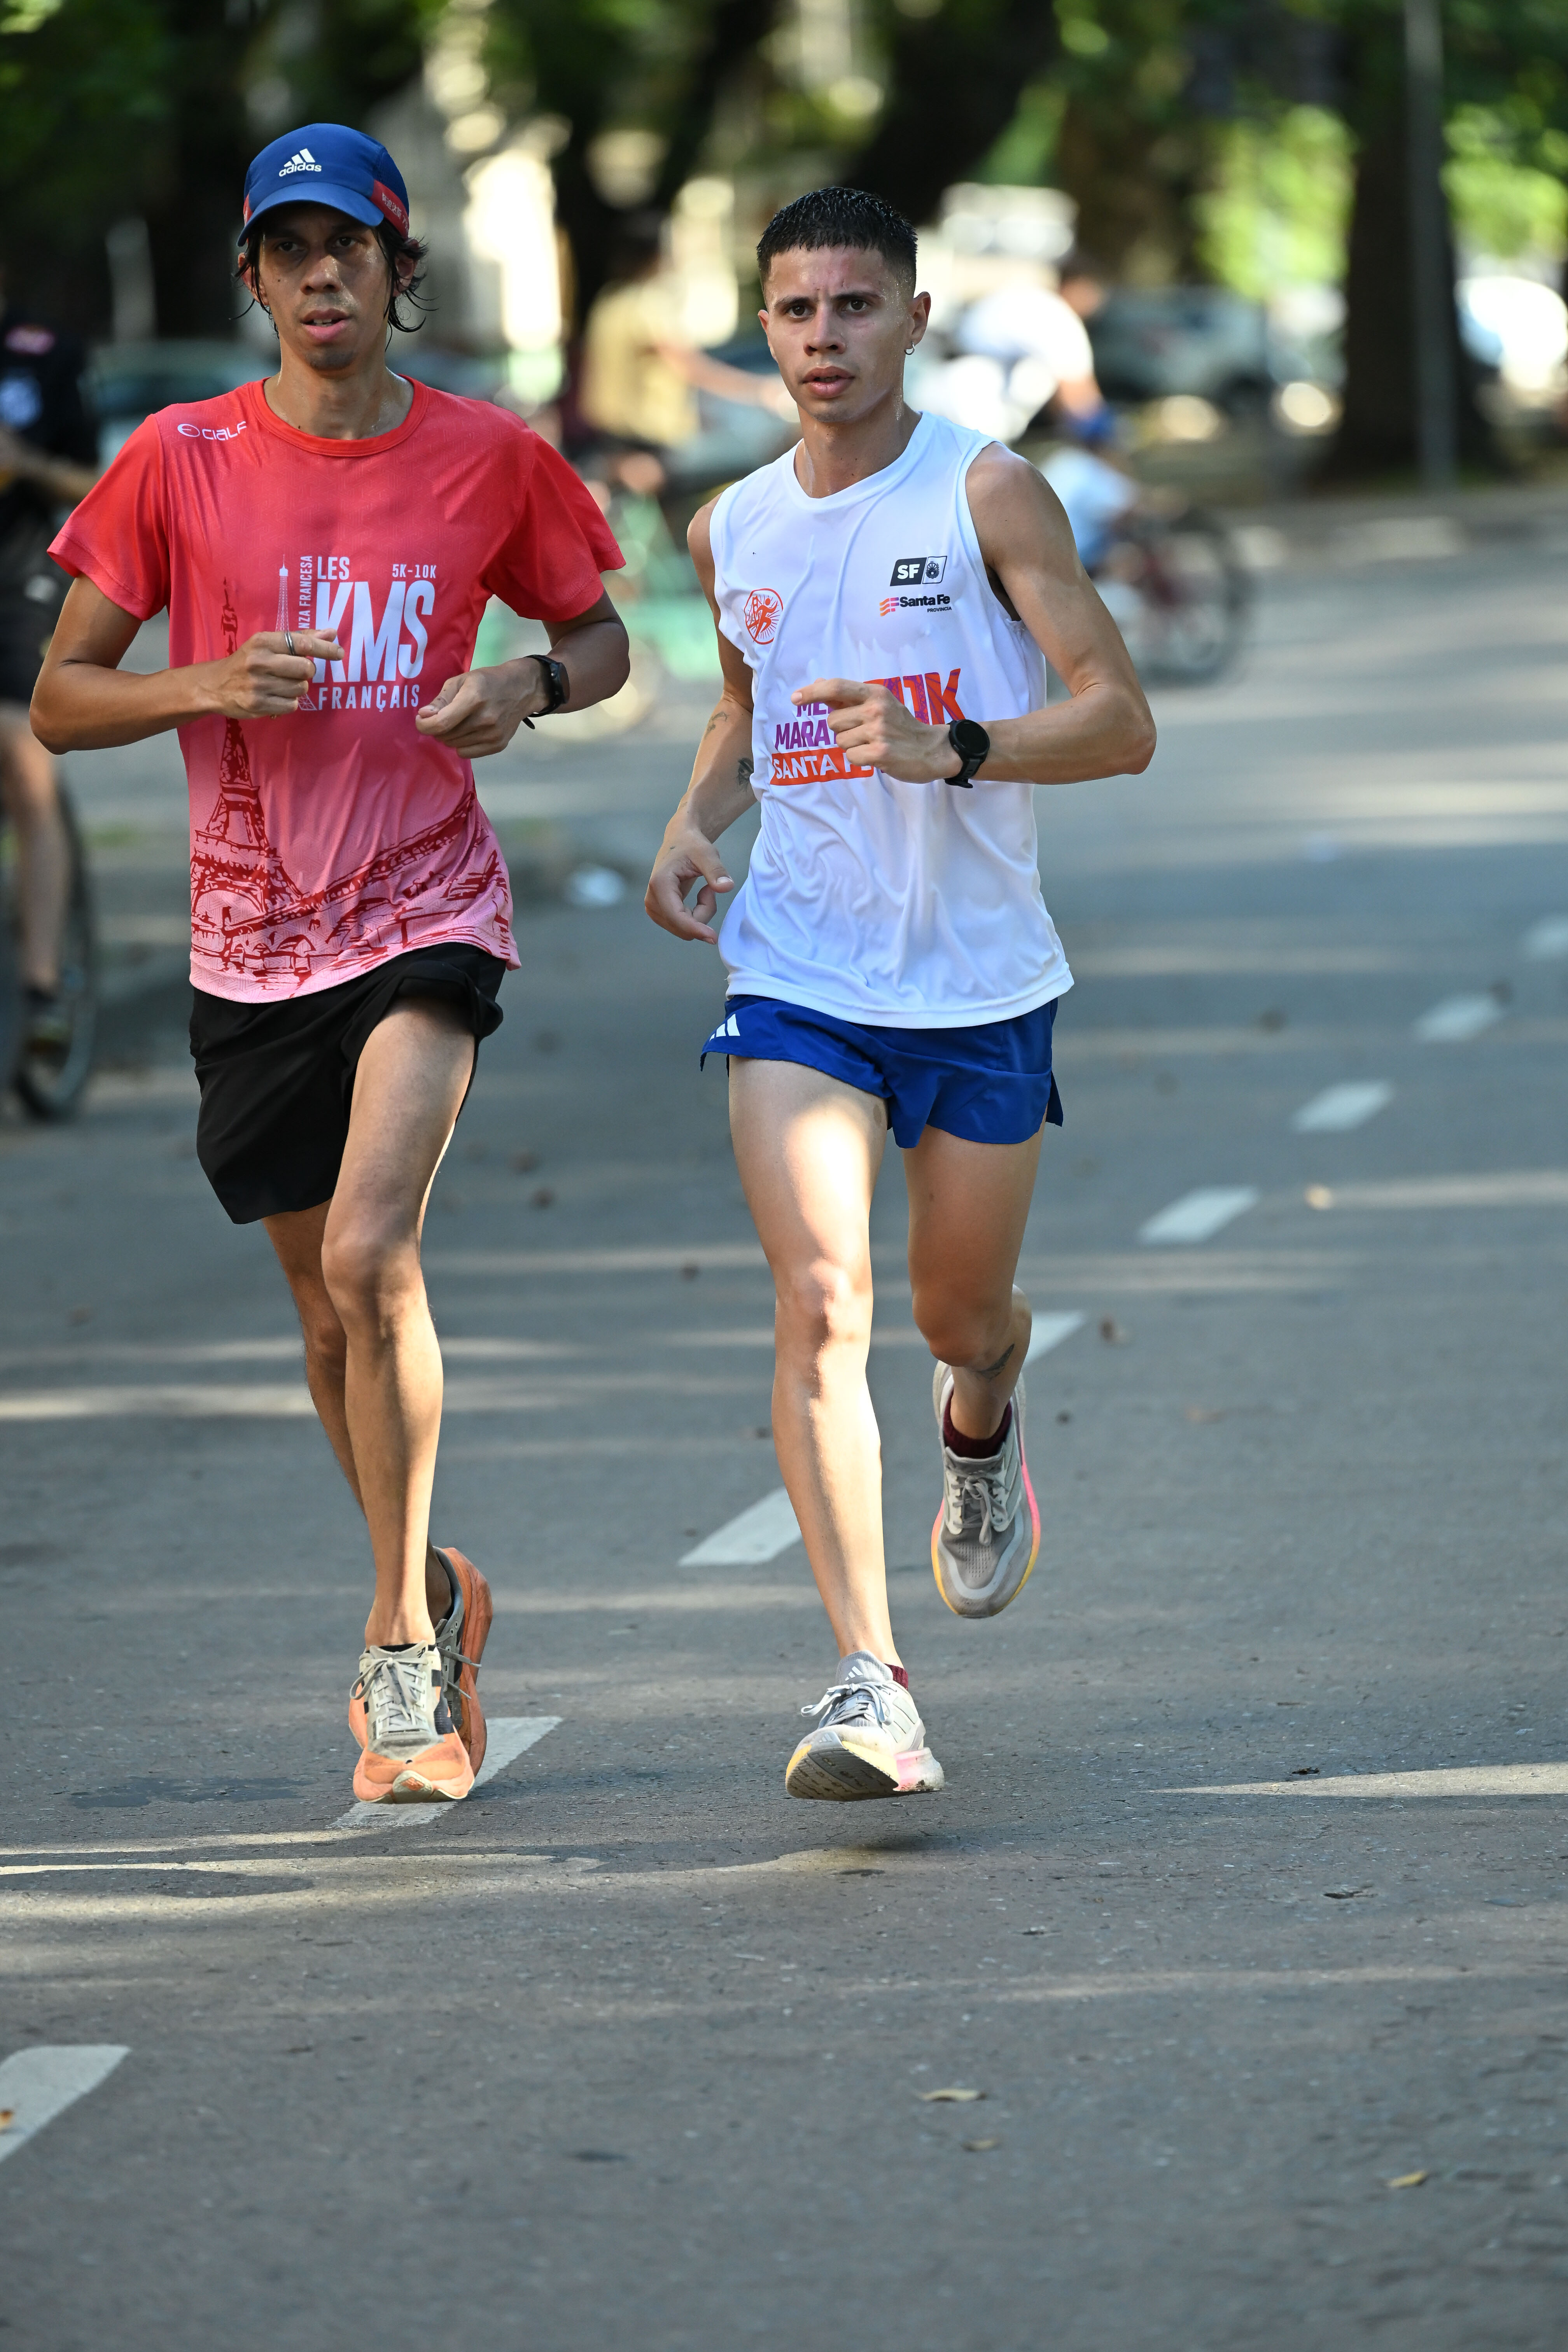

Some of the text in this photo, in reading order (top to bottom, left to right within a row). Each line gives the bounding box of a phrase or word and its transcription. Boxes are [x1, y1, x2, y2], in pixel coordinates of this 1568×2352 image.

[279, 162, 322, 177] adidas
[317, 556, 350, 580] LES
[392, 564, 437, 579] 5K-10K
[897, 564, 920, 579] SF
[299, 555, 313, 606] FRANCESA
[900, 594, 950, 607] Santa Fe
[312, 580, 435, 683] KMS
[318, 684, 420, 712] FRANÇAIS
[773, 754, 840, 779] SANTA
